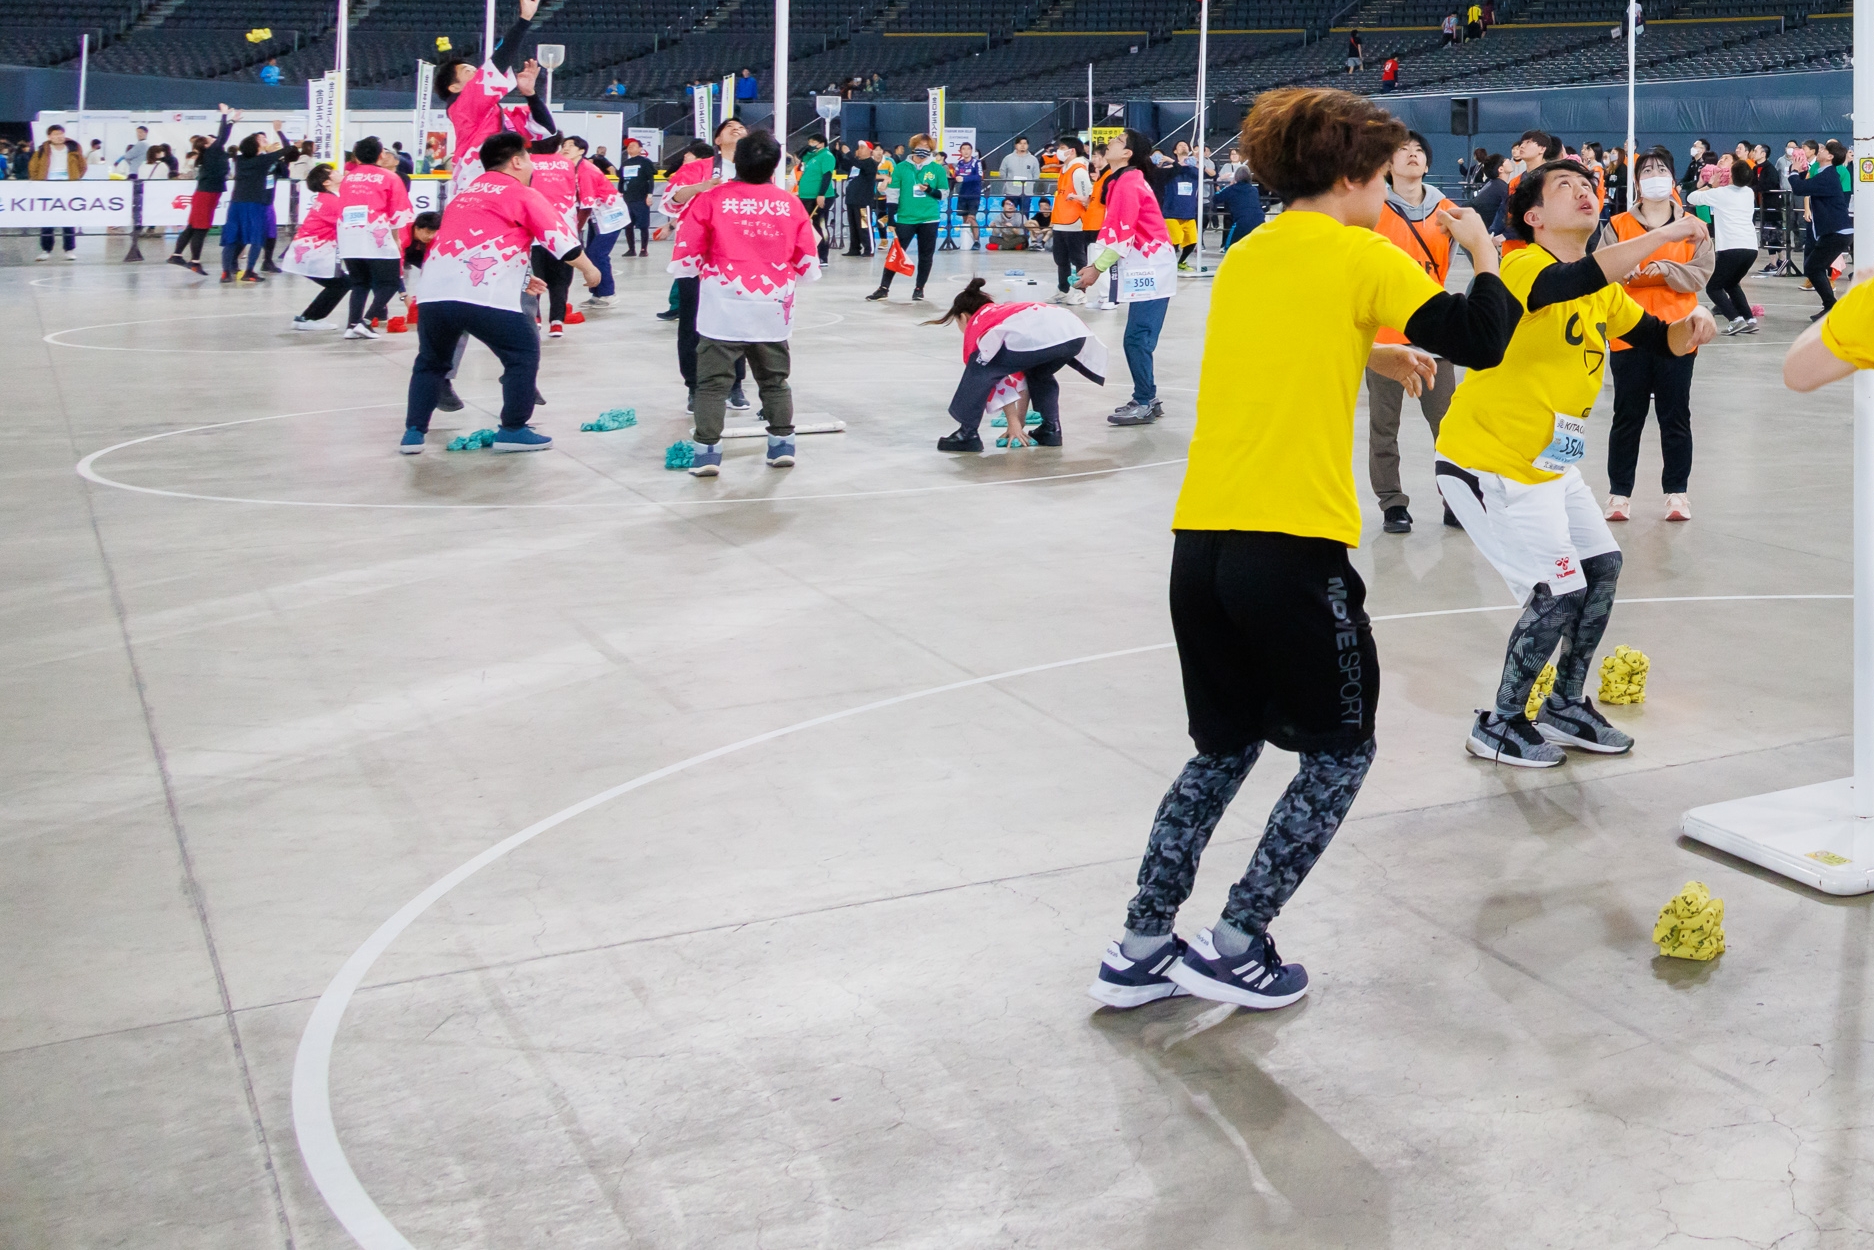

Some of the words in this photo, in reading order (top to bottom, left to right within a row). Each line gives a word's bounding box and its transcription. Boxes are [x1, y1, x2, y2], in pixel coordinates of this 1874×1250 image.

[10, 196, 125, 211] KITAGAS
[721, 197, 791, 217] 共栄火災
[1134, 277, 1155, 288] 3505
[1338, 651, 1363, 730] SPORT
